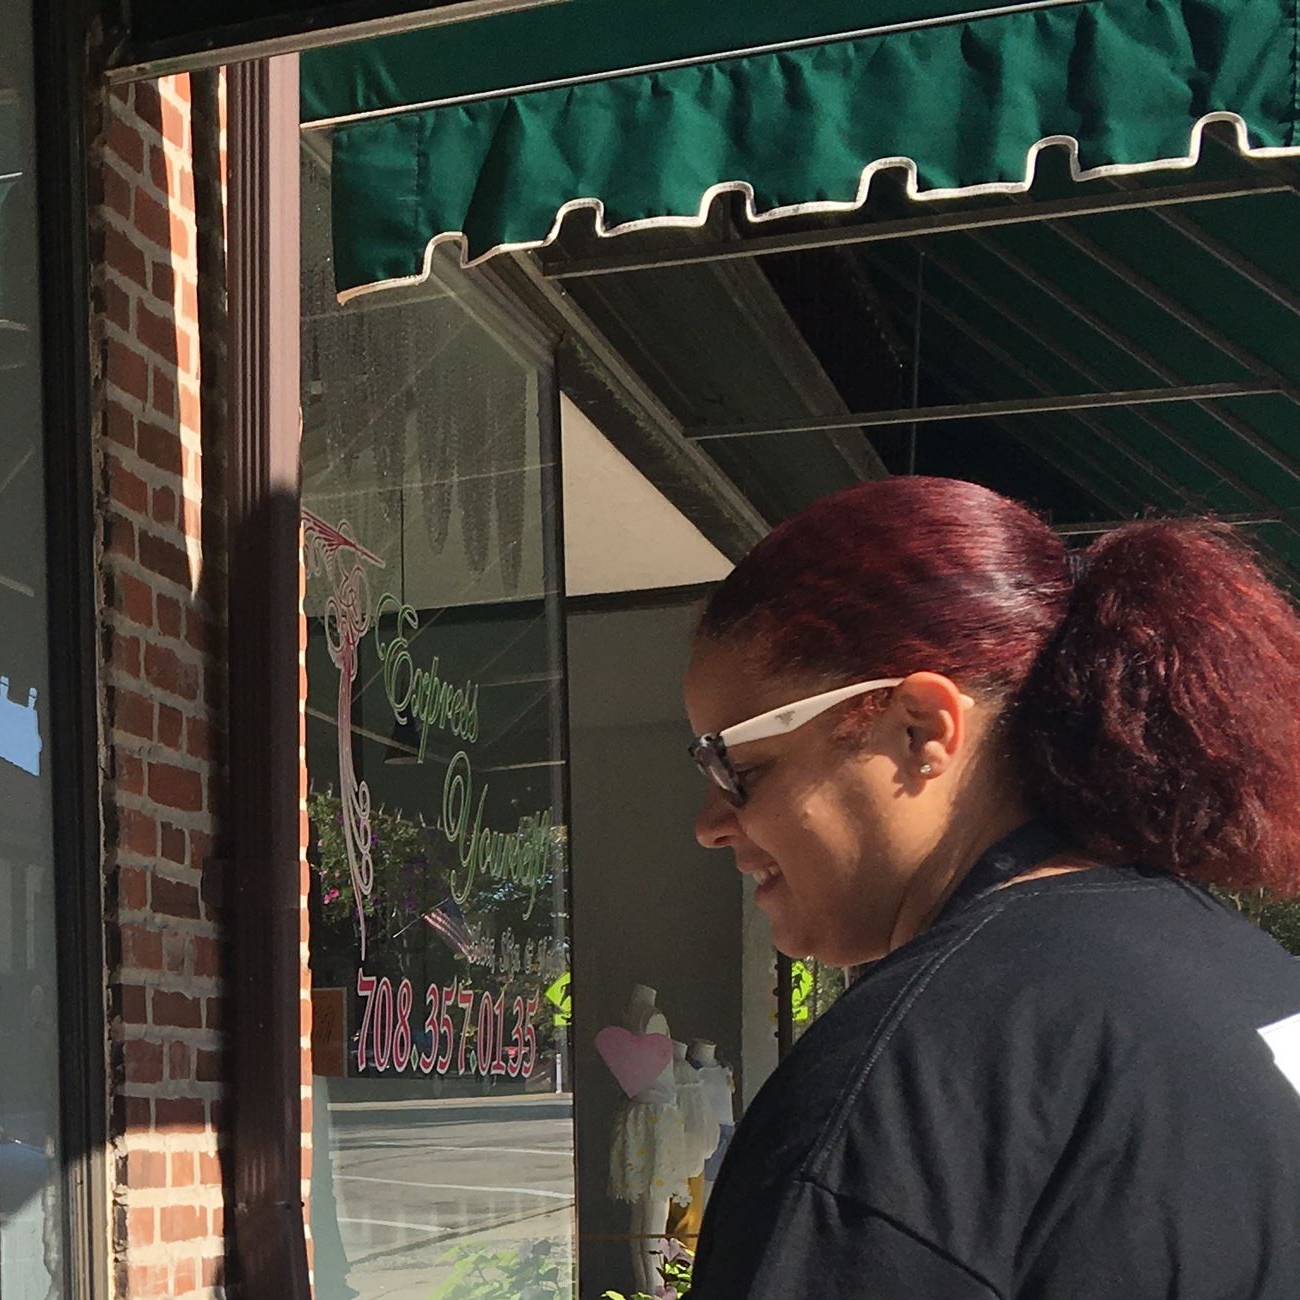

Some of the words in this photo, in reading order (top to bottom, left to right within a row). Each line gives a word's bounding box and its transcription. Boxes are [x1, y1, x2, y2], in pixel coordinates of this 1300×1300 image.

[374, 592, 479, 764] Express
[442, 751, 554, 921] Yourself
[357, 967, 540, 1078] 708.357.0135
